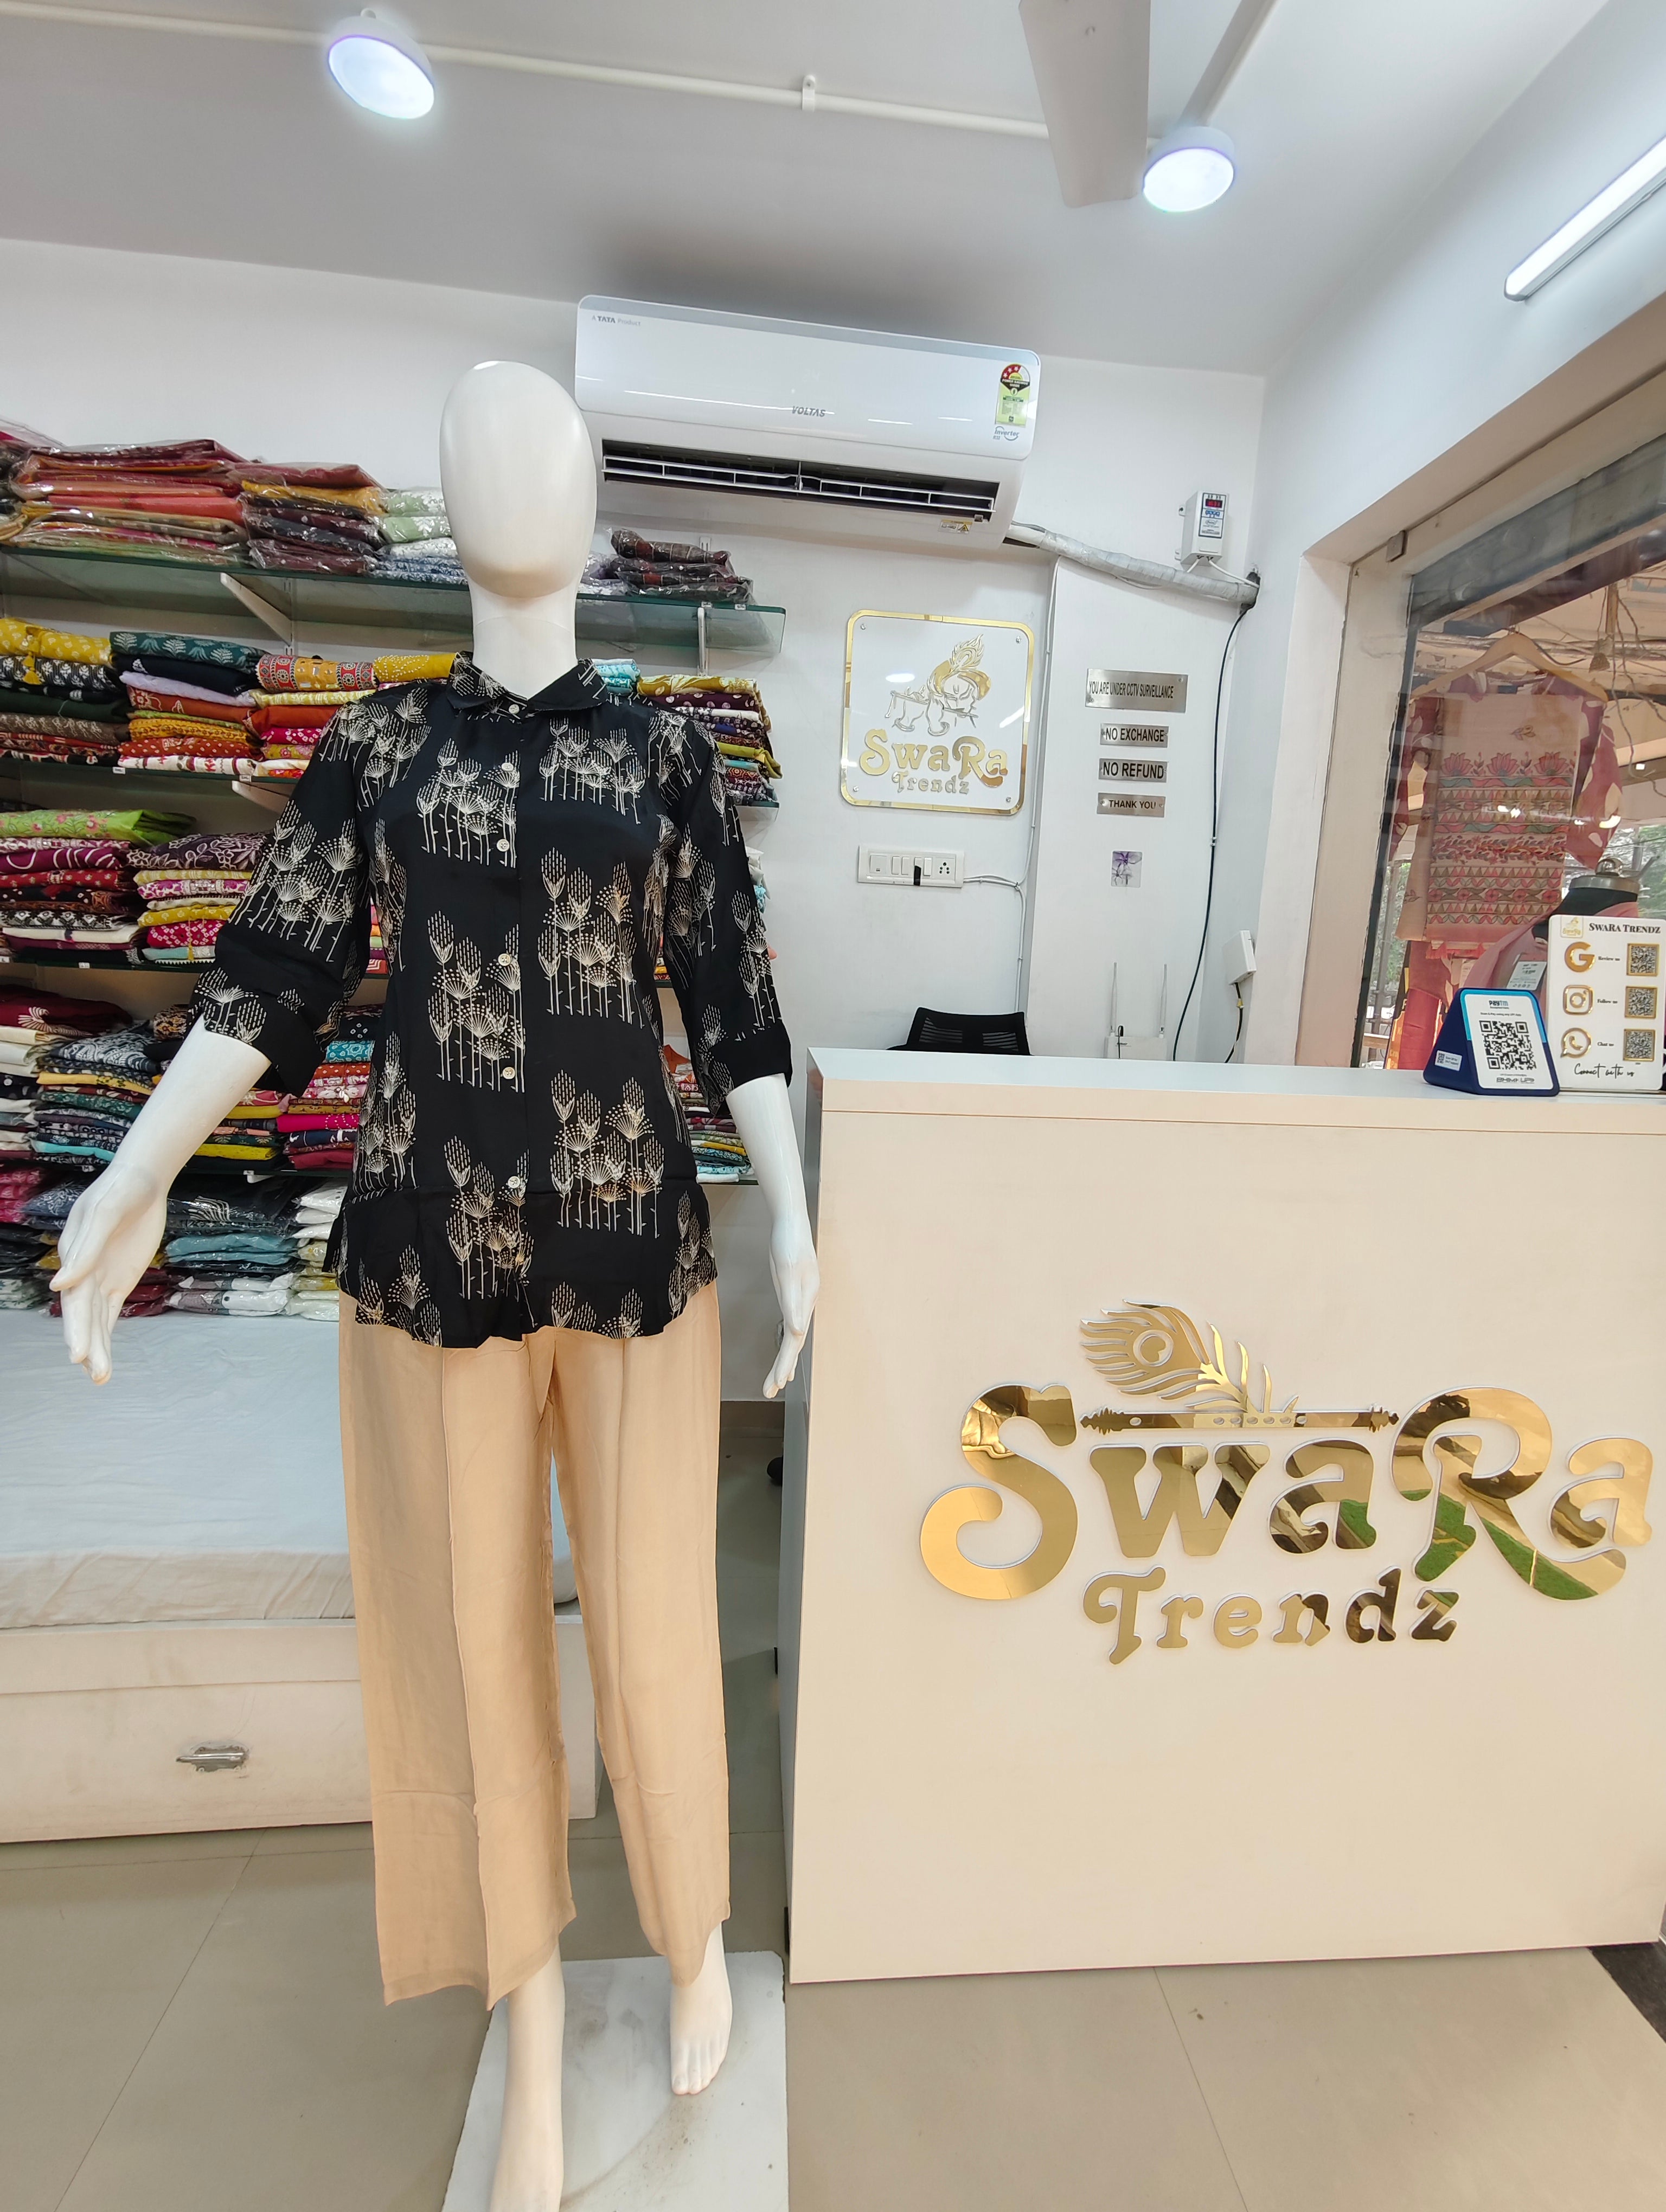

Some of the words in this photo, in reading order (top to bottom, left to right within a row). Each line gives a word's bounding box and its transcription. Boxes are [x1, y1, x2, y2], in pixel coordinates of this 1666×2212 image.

[792, 406, 826, 417] VOLTAS
[1089, 681, 1099, 695] YOU
[1099, 681, 1110, 695] ARE
[1110, 682, 1126, 696] UNDER
[1127, 683, 1139, 696] CCTV
[1139, 684, 1174, 699] SURVEILLANCE
[1106, 728, 1118, 741] NO
[1120, 728, 1165, 742] EXCHANGE
[860, 729, 1008, 788] SwaRa
[1103, 762, 1119, 776] NO
[1122, 763, 1164, 779] REFUND
[892, 771, 970, 794] Trendz
[1108, 800, 1137, 808] THANK
[1139, 801, 1156, 809] YOU
[1574, 1063, 1606, 1078] Connect
[1605, 1064, 1624, 1079] with
[919, 1384, 1654, 1601] SwaRa
[1082, 1565, 1461, 1666] Trendz
